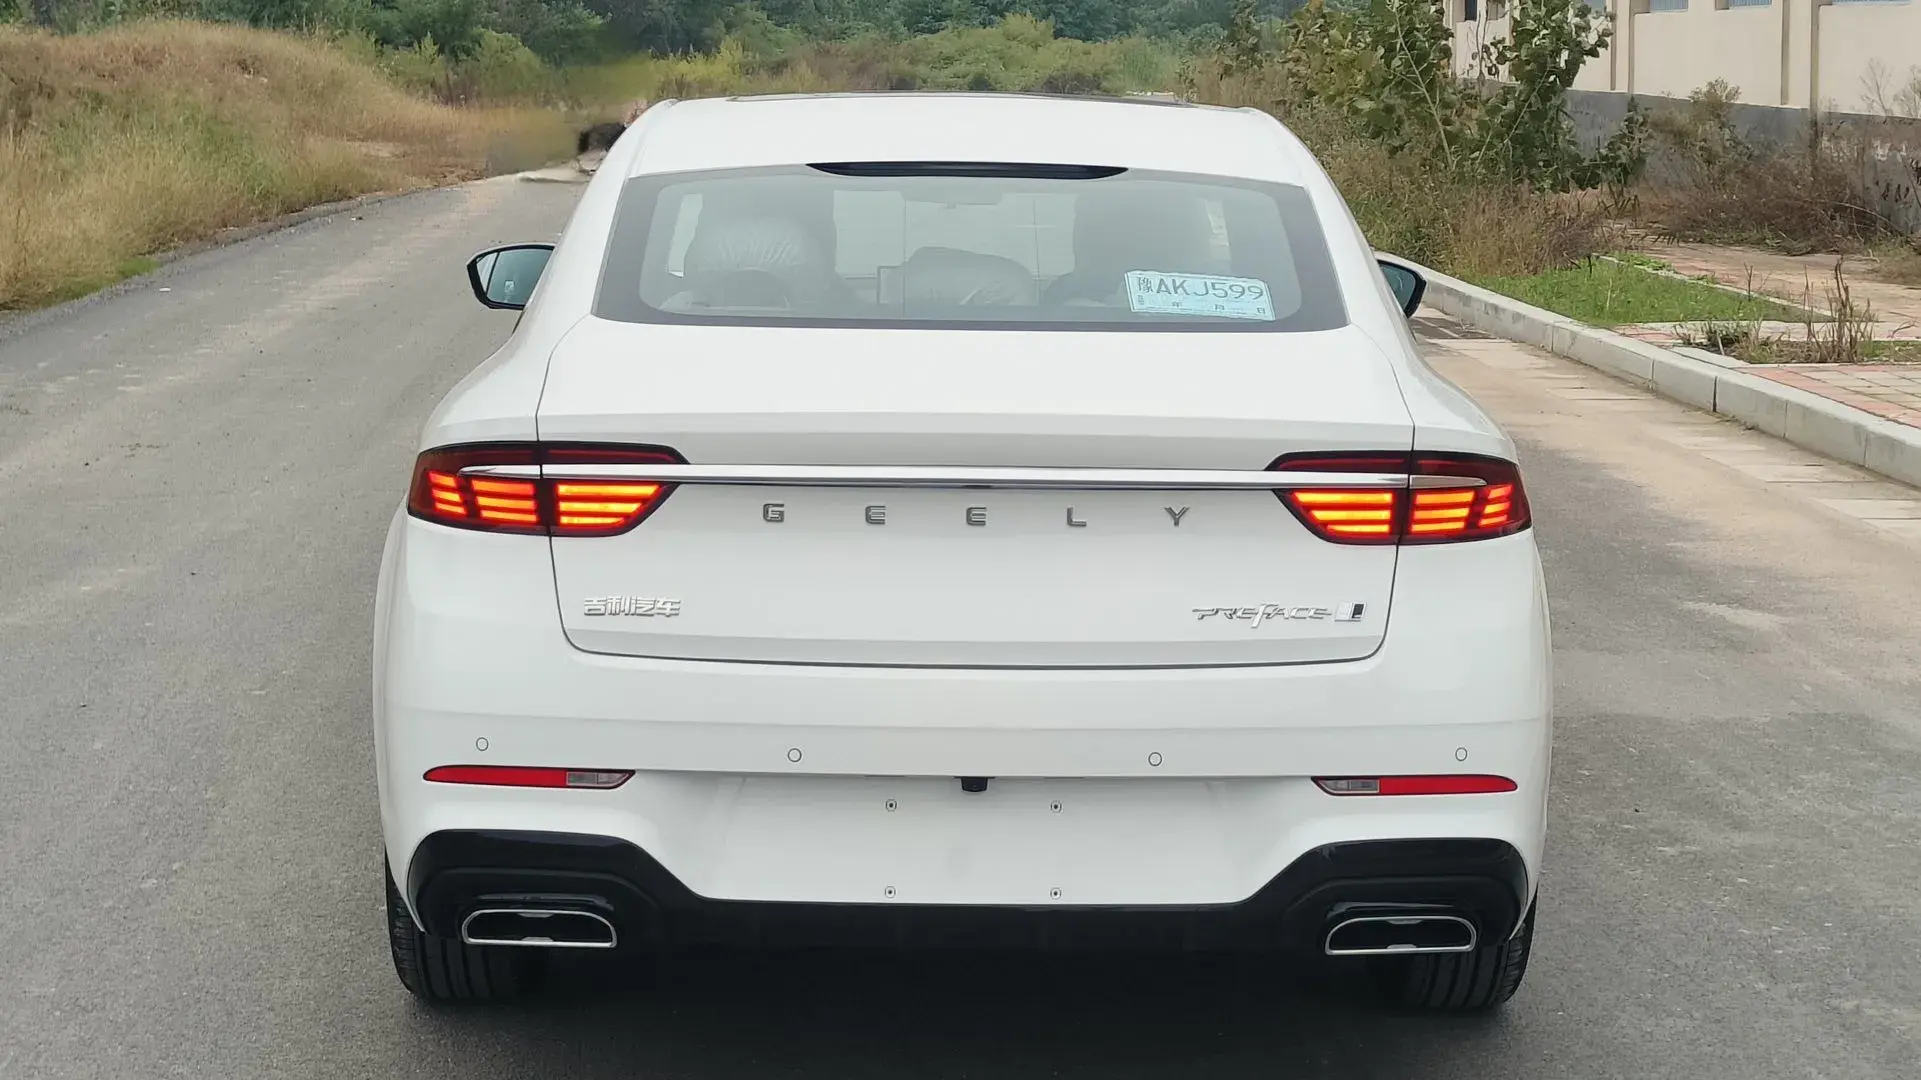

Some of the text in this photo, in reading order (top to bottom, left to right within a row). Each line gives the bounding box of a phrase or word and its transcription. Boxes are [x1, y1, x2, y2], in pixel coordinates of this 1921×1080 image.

[762, 503, 1190, 528] GEELY
[583, 596, 681, 617] 吉利汽车
